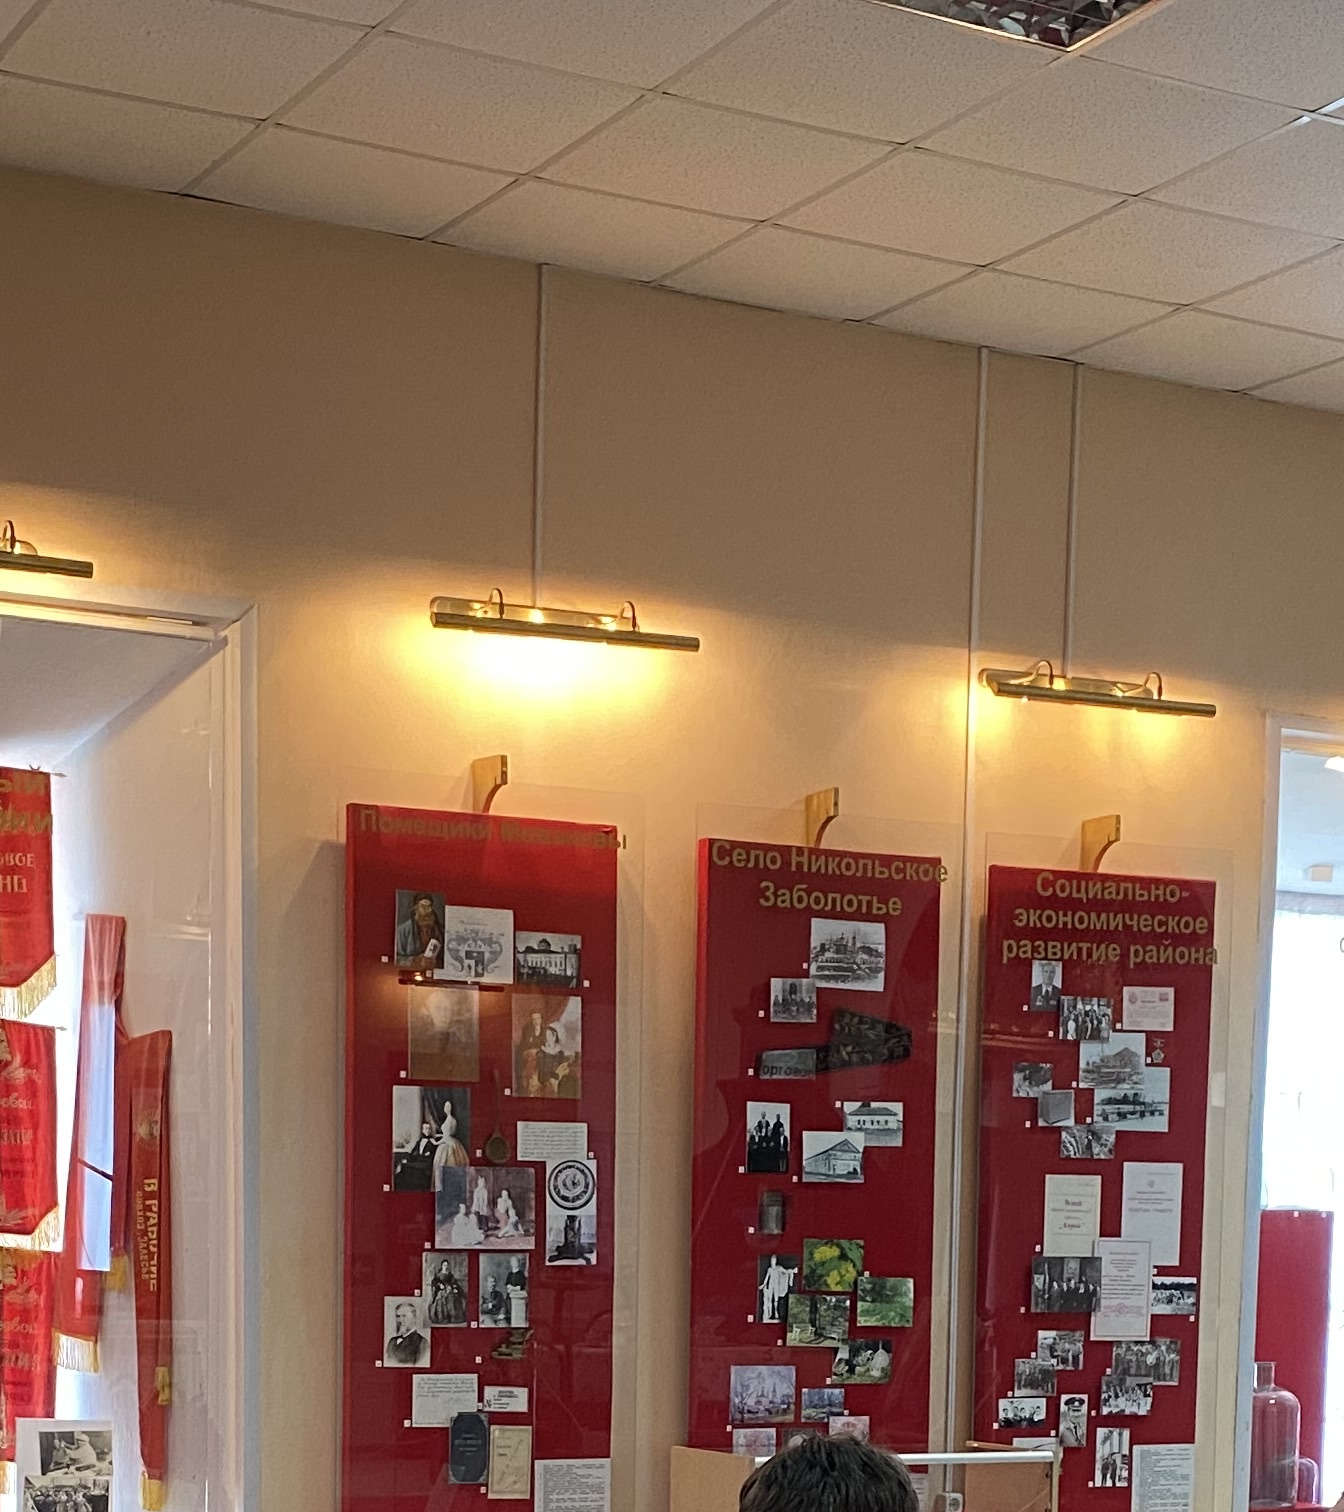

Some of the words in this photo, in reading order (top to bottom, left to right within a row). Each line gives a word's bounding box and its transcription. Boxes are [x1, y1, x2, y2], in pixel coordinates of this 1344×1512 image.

[711, 840, 782, 870] Село
[791, 847, 948, 884] Никольское
[758, 880, 903, 916] Заболотье
[1036, 871, 1191, 904] Социально-
[1013, 908, 1209, 934] экономическое
[1002, 938, 1122, 963] развитие
[1129, 939, 1218, 968] района
